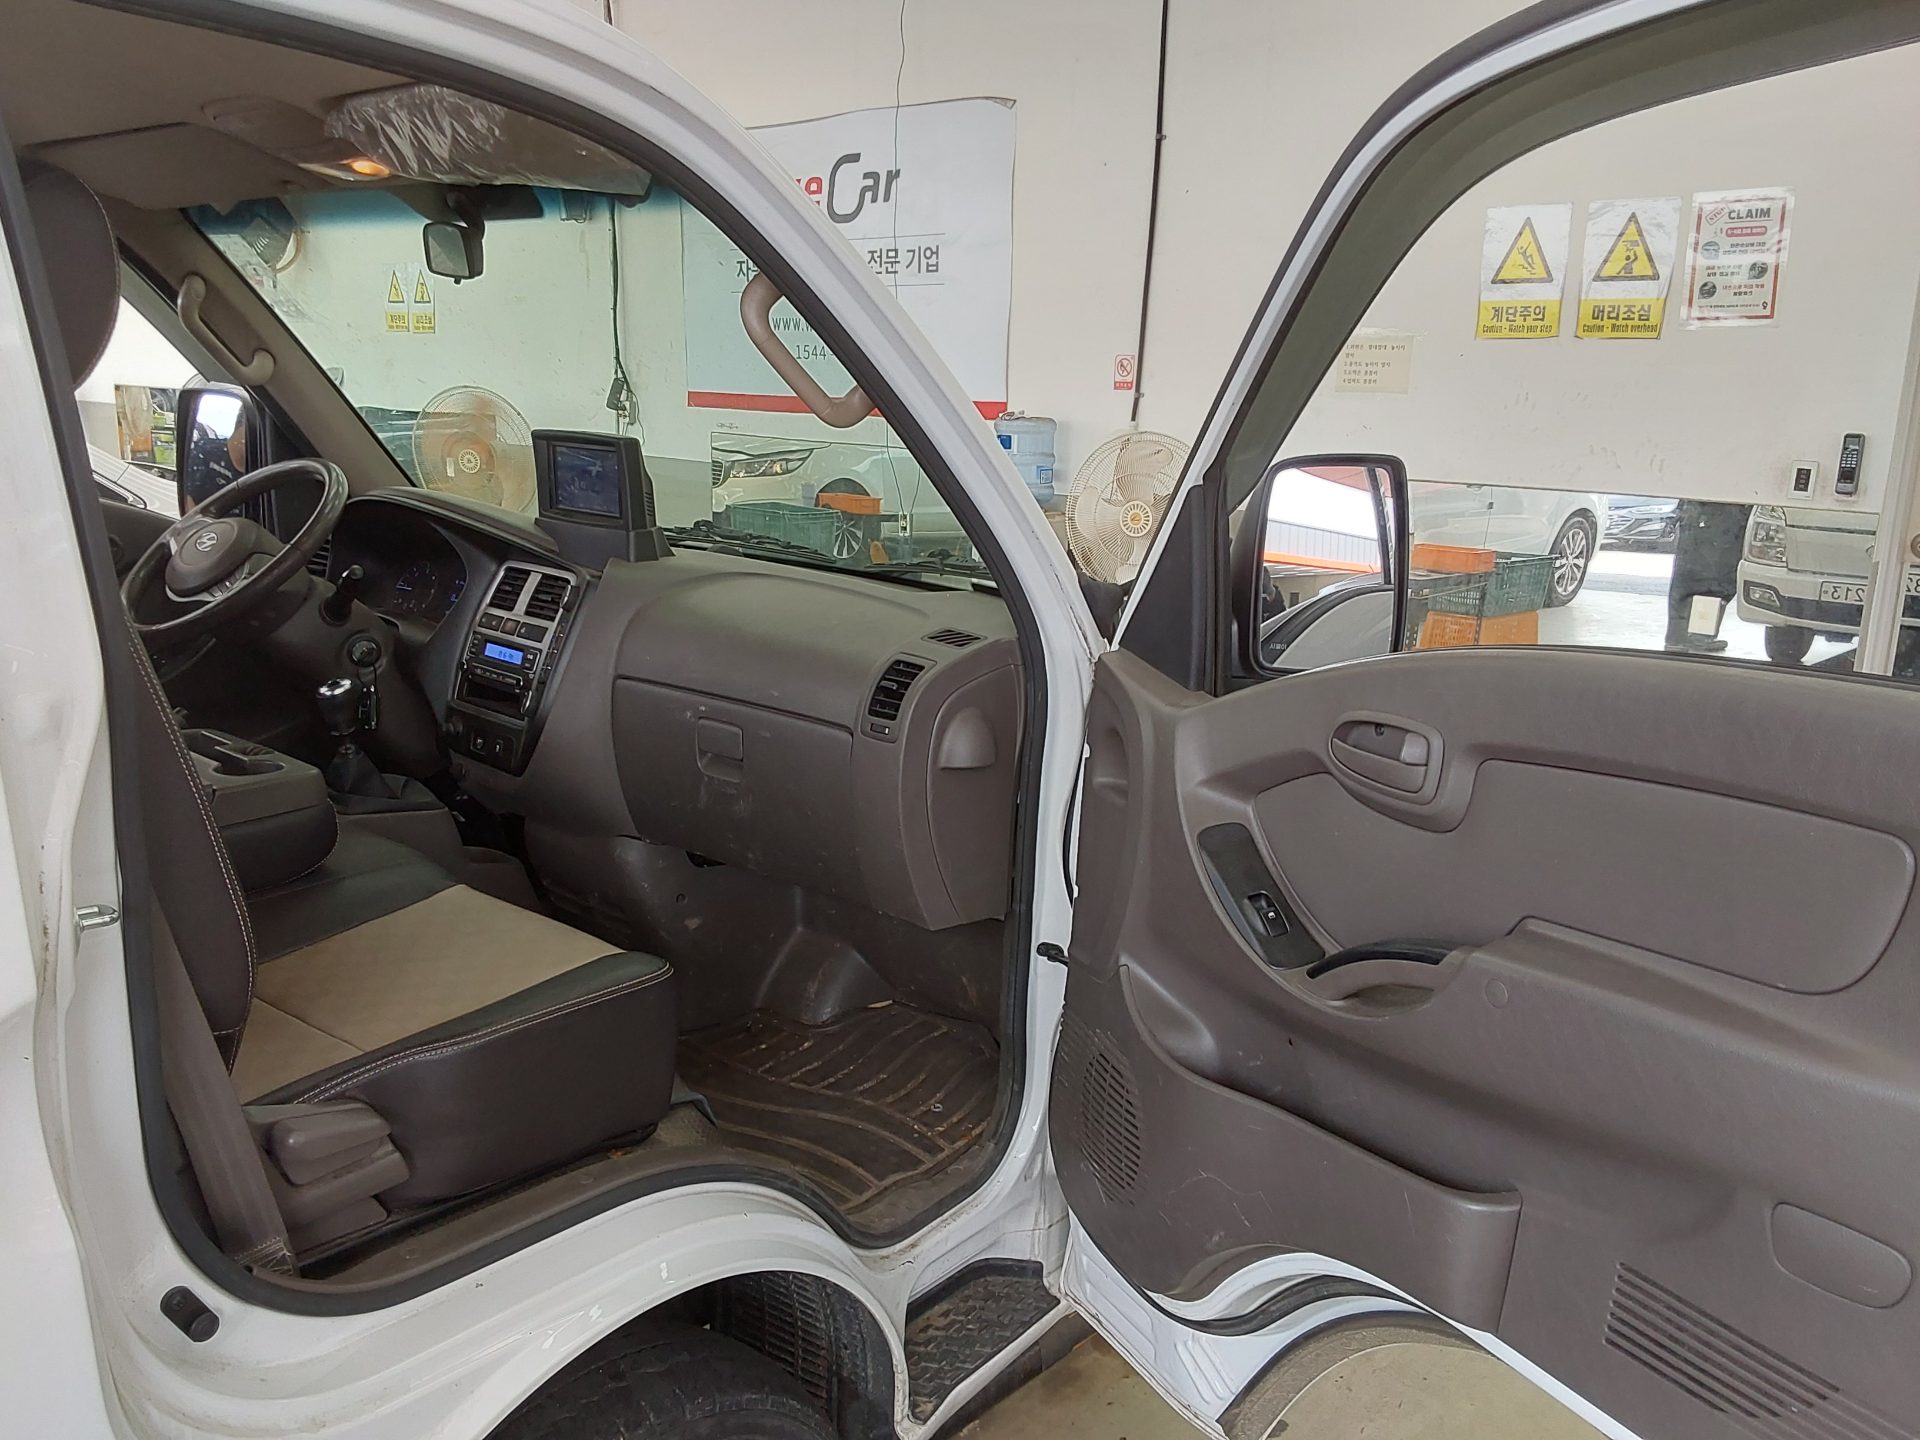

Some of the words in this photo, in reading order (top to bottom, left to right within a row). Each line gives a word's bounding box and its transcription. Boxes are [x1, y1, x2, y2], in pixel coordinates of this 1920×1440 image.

[1728, 207, 1771, 220] CLAIM
[867, 247, 900, 275] 전문
[906, 245, 940, 274] 기업
[1490, 305, 1547, 322] 계단주의
[1592, 304, 1651, 322] 머리조심
[1482, 323, 1503, 333] Caution
[1509, 323, 1525, 333] Watch
[1526, 324, 1539, 334] your
[1540, 324, 1553, 335] step
[1582, 323, 1604, 333] Caution
[1611, 323, 1628, 333] Watch
[1630, 323, 1658, 333] overhead
[796, 345, 827, 360] 1544
